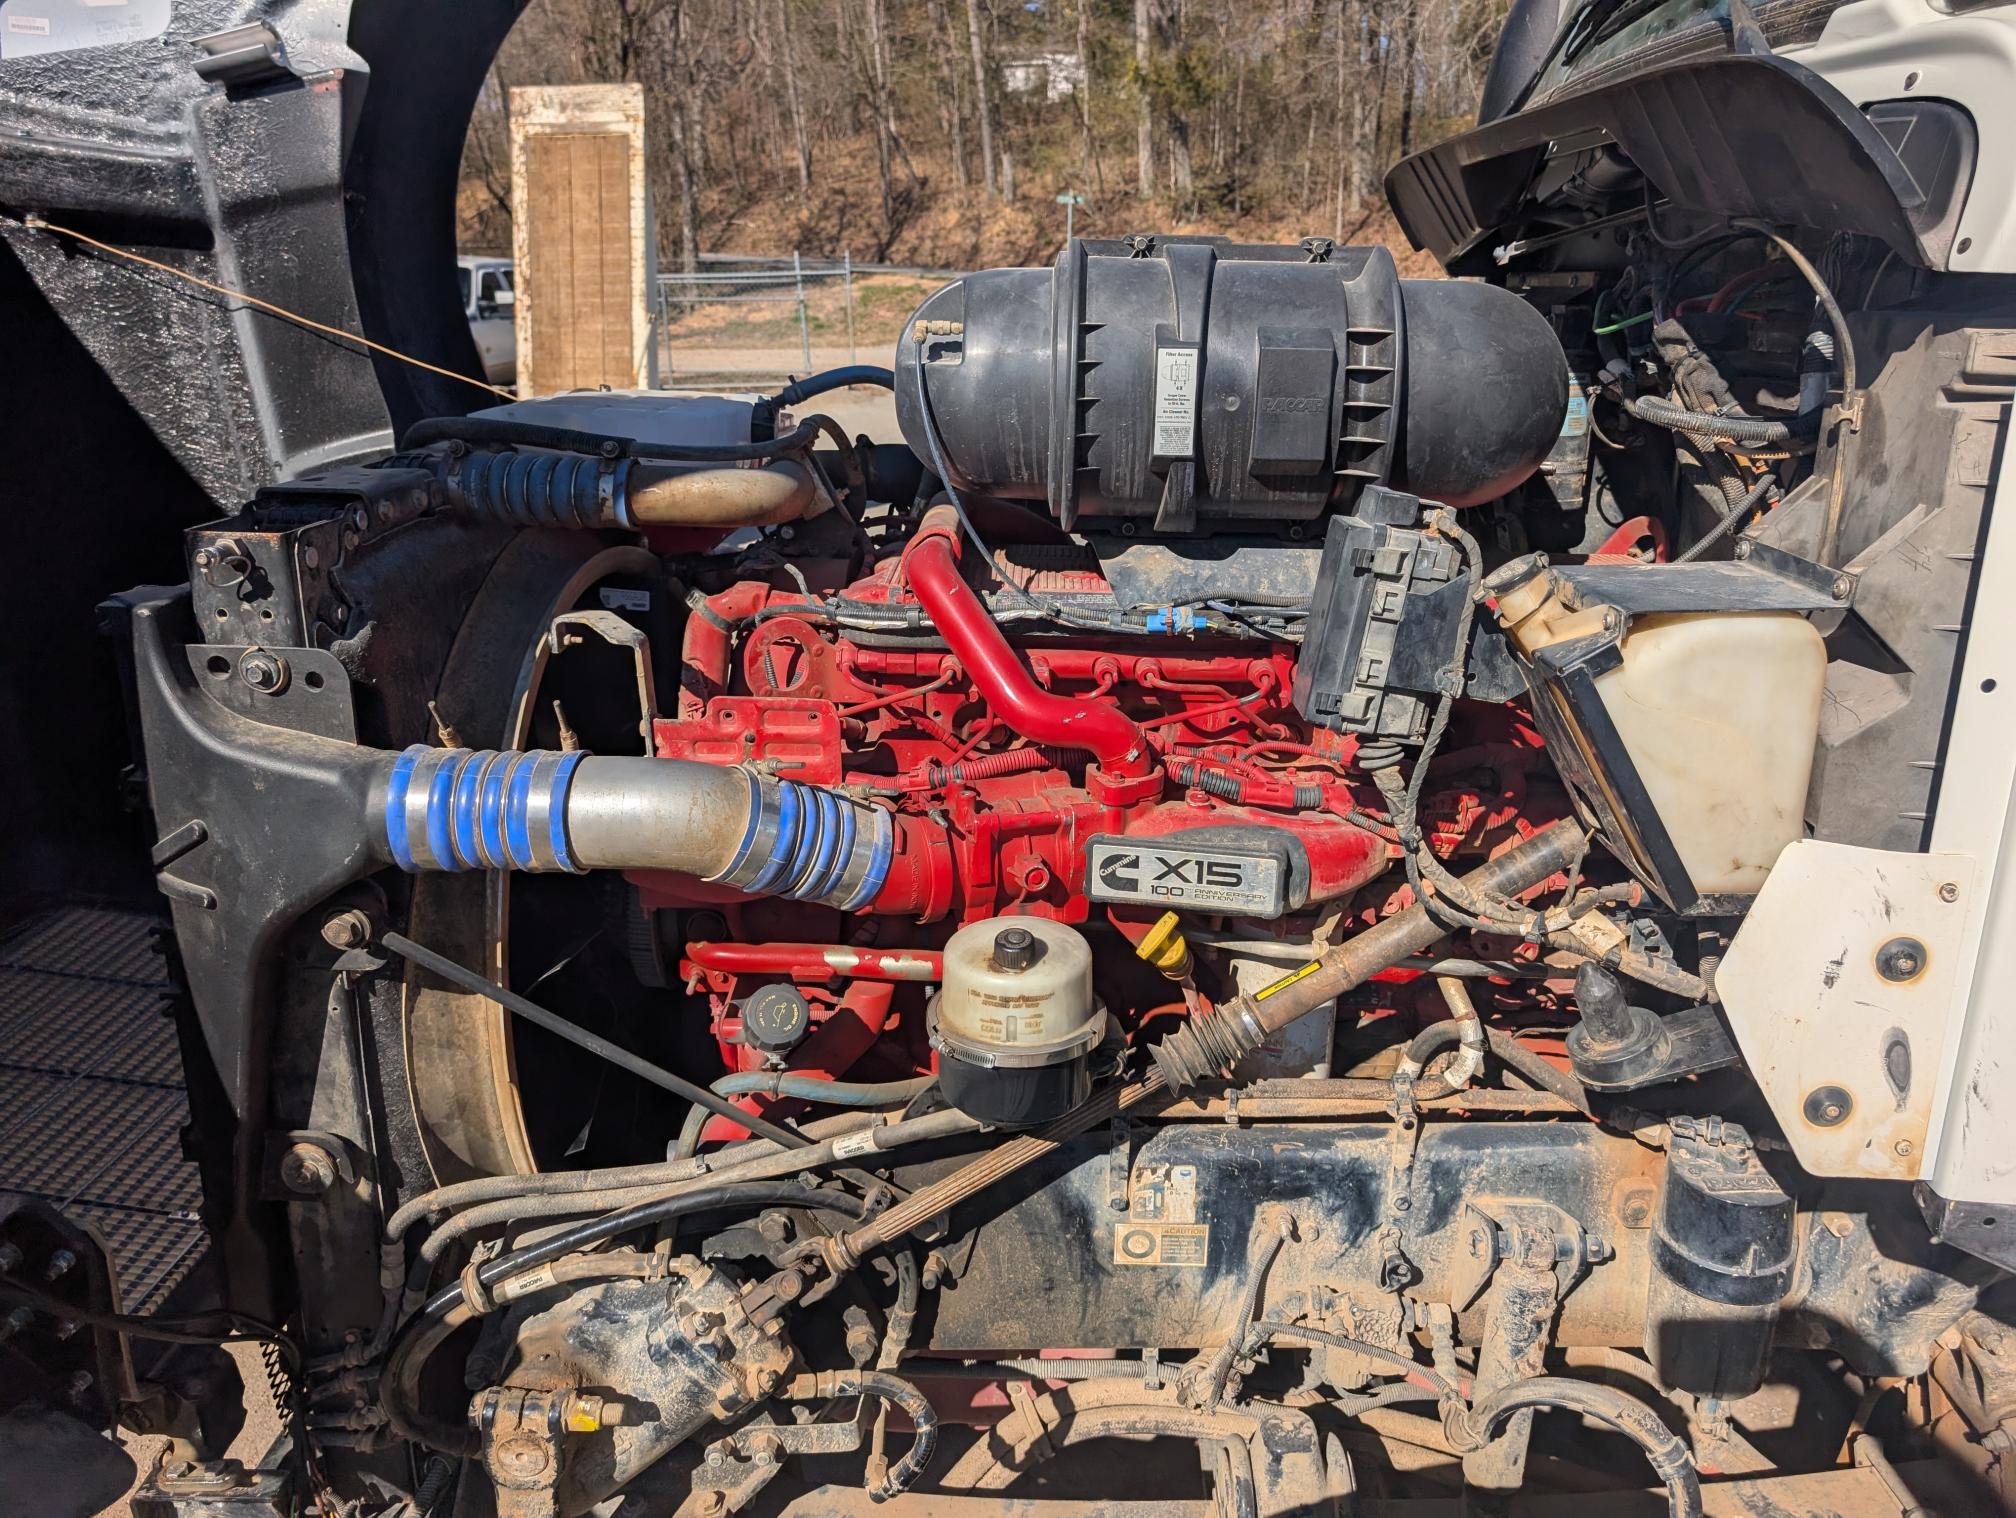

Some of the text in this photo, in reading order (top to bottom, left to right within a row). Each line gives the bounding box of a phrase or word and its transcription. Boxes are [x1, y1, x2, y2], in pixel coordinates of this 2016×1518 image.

[1099, 854, 1137, 877] Cummins
[1152, 856, 1243, 888] X15
[1194, 888, 1268, 900] ANNIVERSARY
[1194, 893, 1235, 902] EDITION
[1169, 1226, 1205, 1235] CAUTION
[519, 1275, 544, 1290] PACCAR
